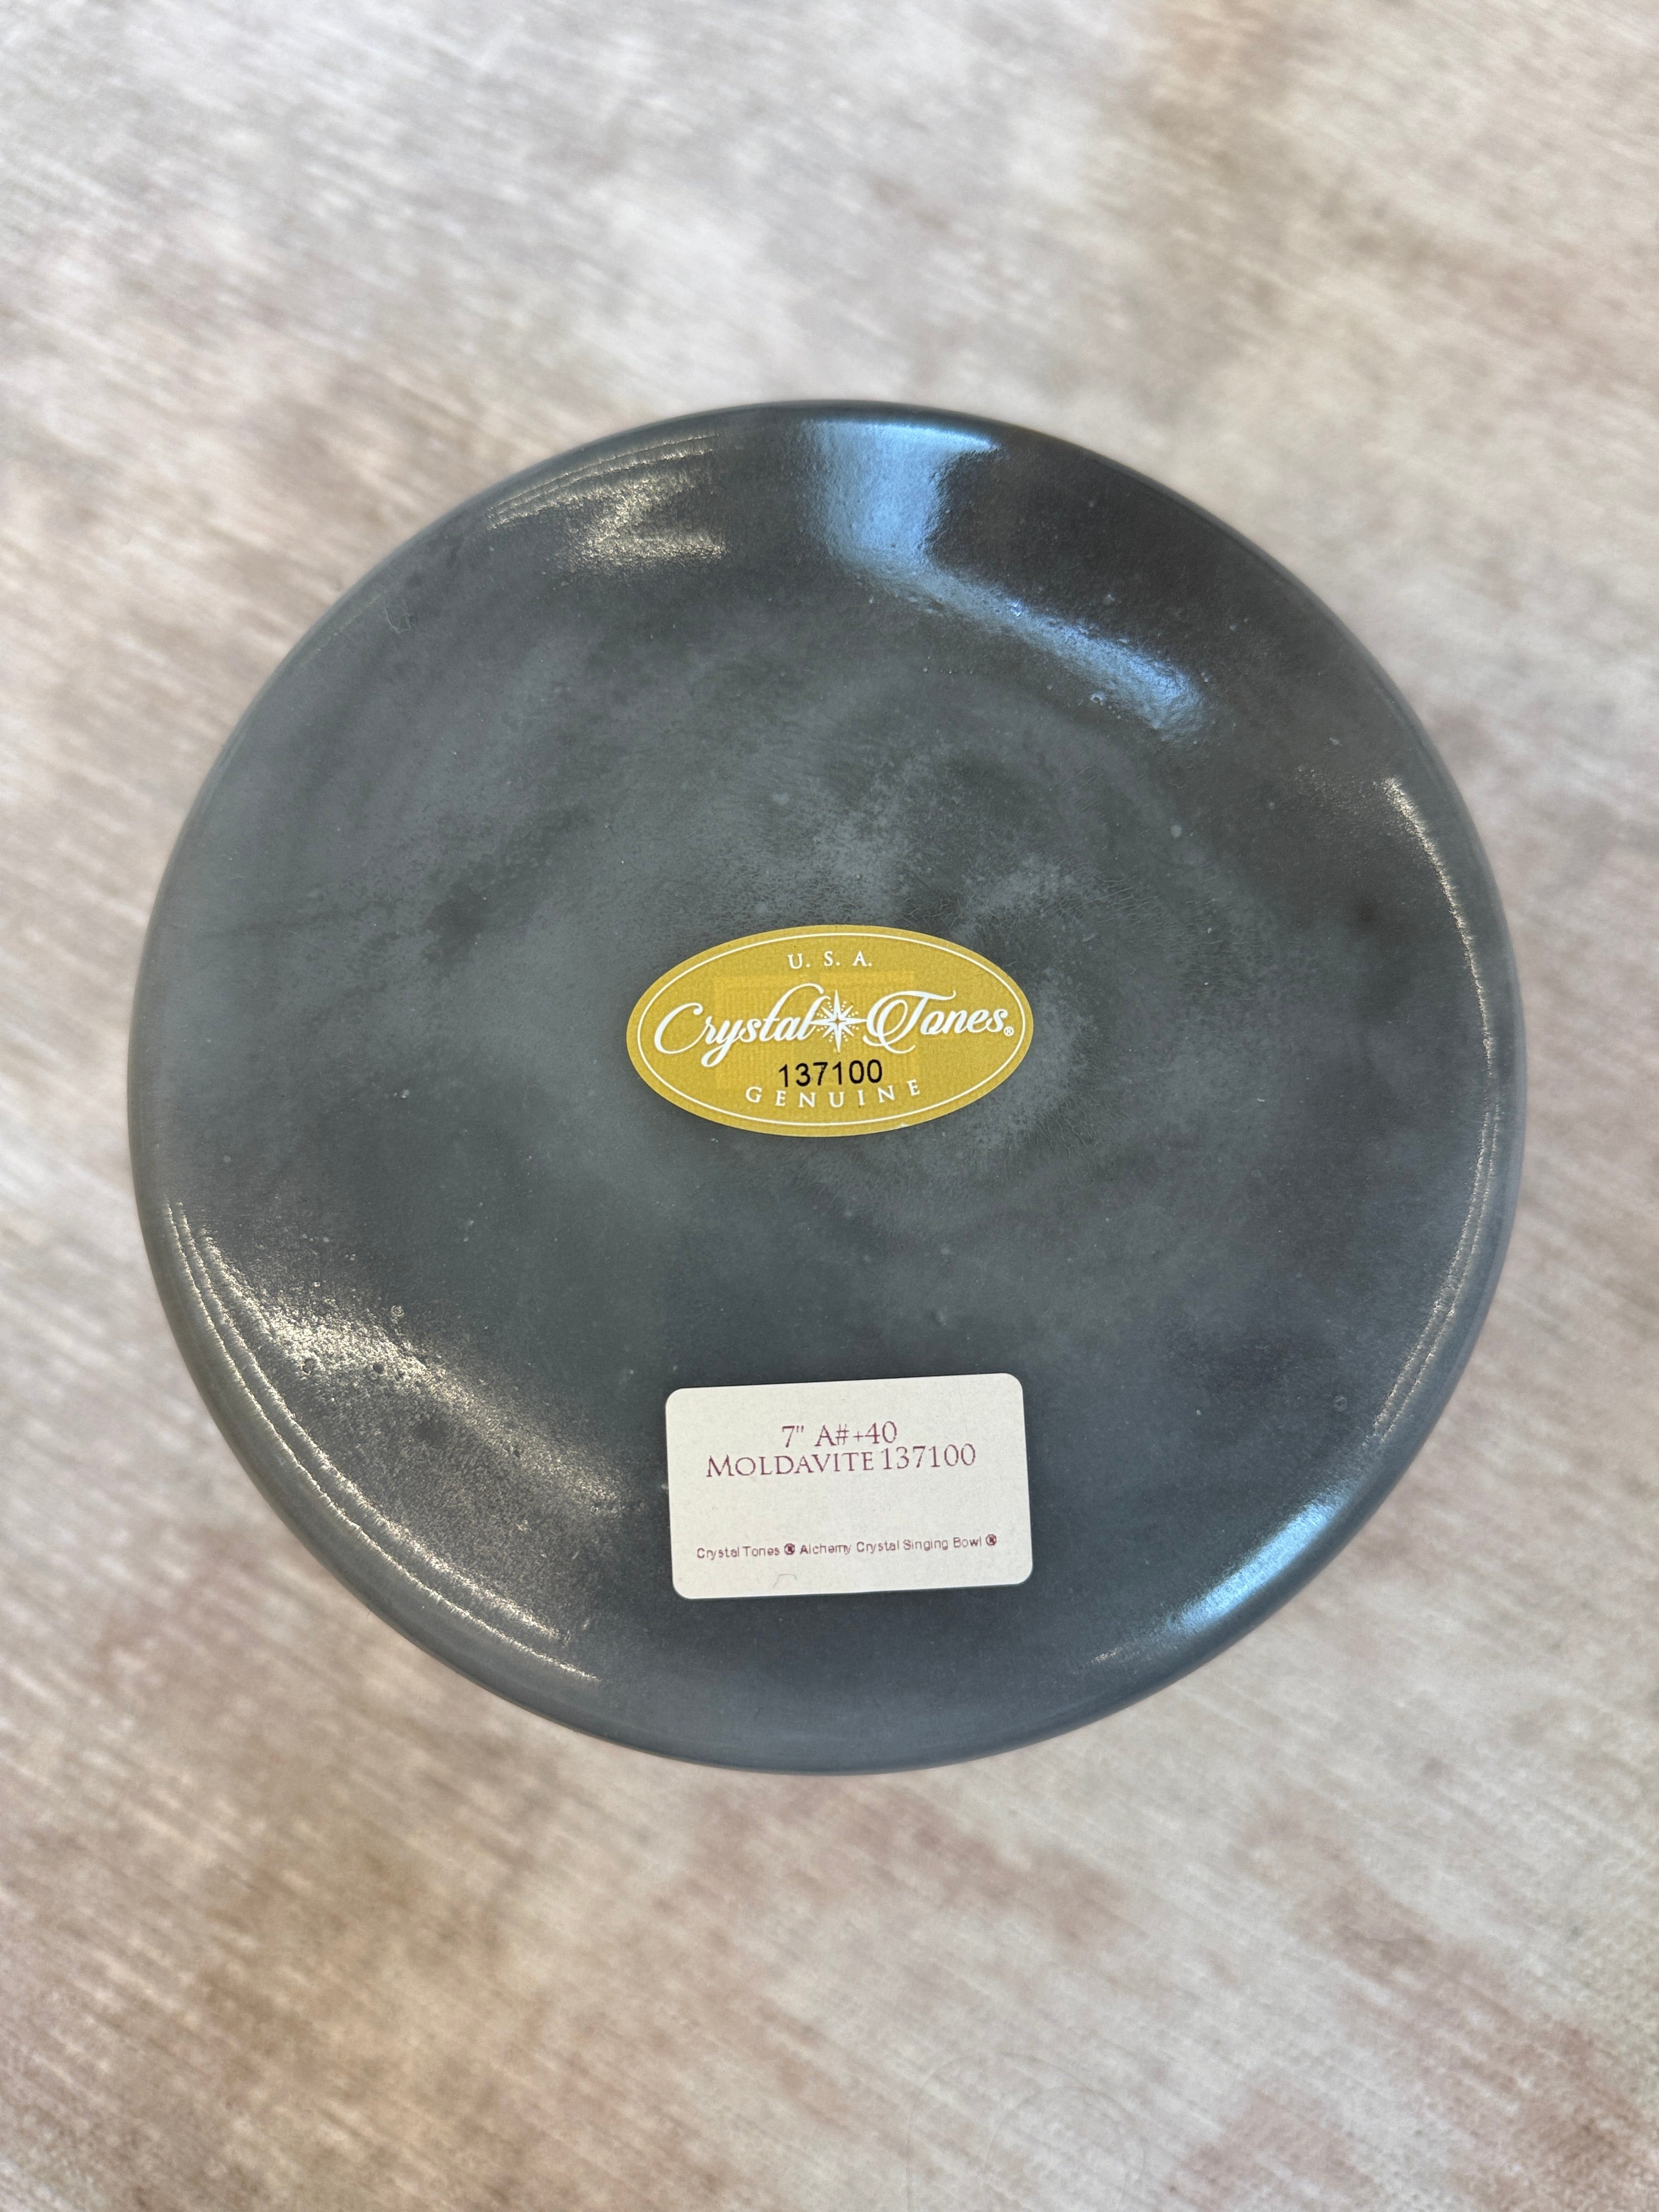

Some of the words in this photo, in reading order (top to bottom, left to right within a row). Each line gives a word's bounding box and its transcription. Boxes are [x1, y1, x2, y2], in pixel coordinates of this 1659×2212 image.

[654, 983, 830, 1068] Crystal
[778, 1059, 883, 1087] 137100
[746, 1079, 921, 1108] GENUINE
[782, 1425, 804, 1447] 7"
[815, 1421, 897, 1446] A#+40
[706, 1451, 874, 1477] MOLDAVITE
[882, 1443, 975, 1470] 137100
[697, 1546, 740, 1560] Crystal
[744, 1545, 780, 1556] Tones
[799, 1543, 851, 1554] Alchemy
[856, 1540, 900, 1553] Crystal
[903, 1538, 949, 1552] Singing
[953, 1536, 982, 1548] Bowl
